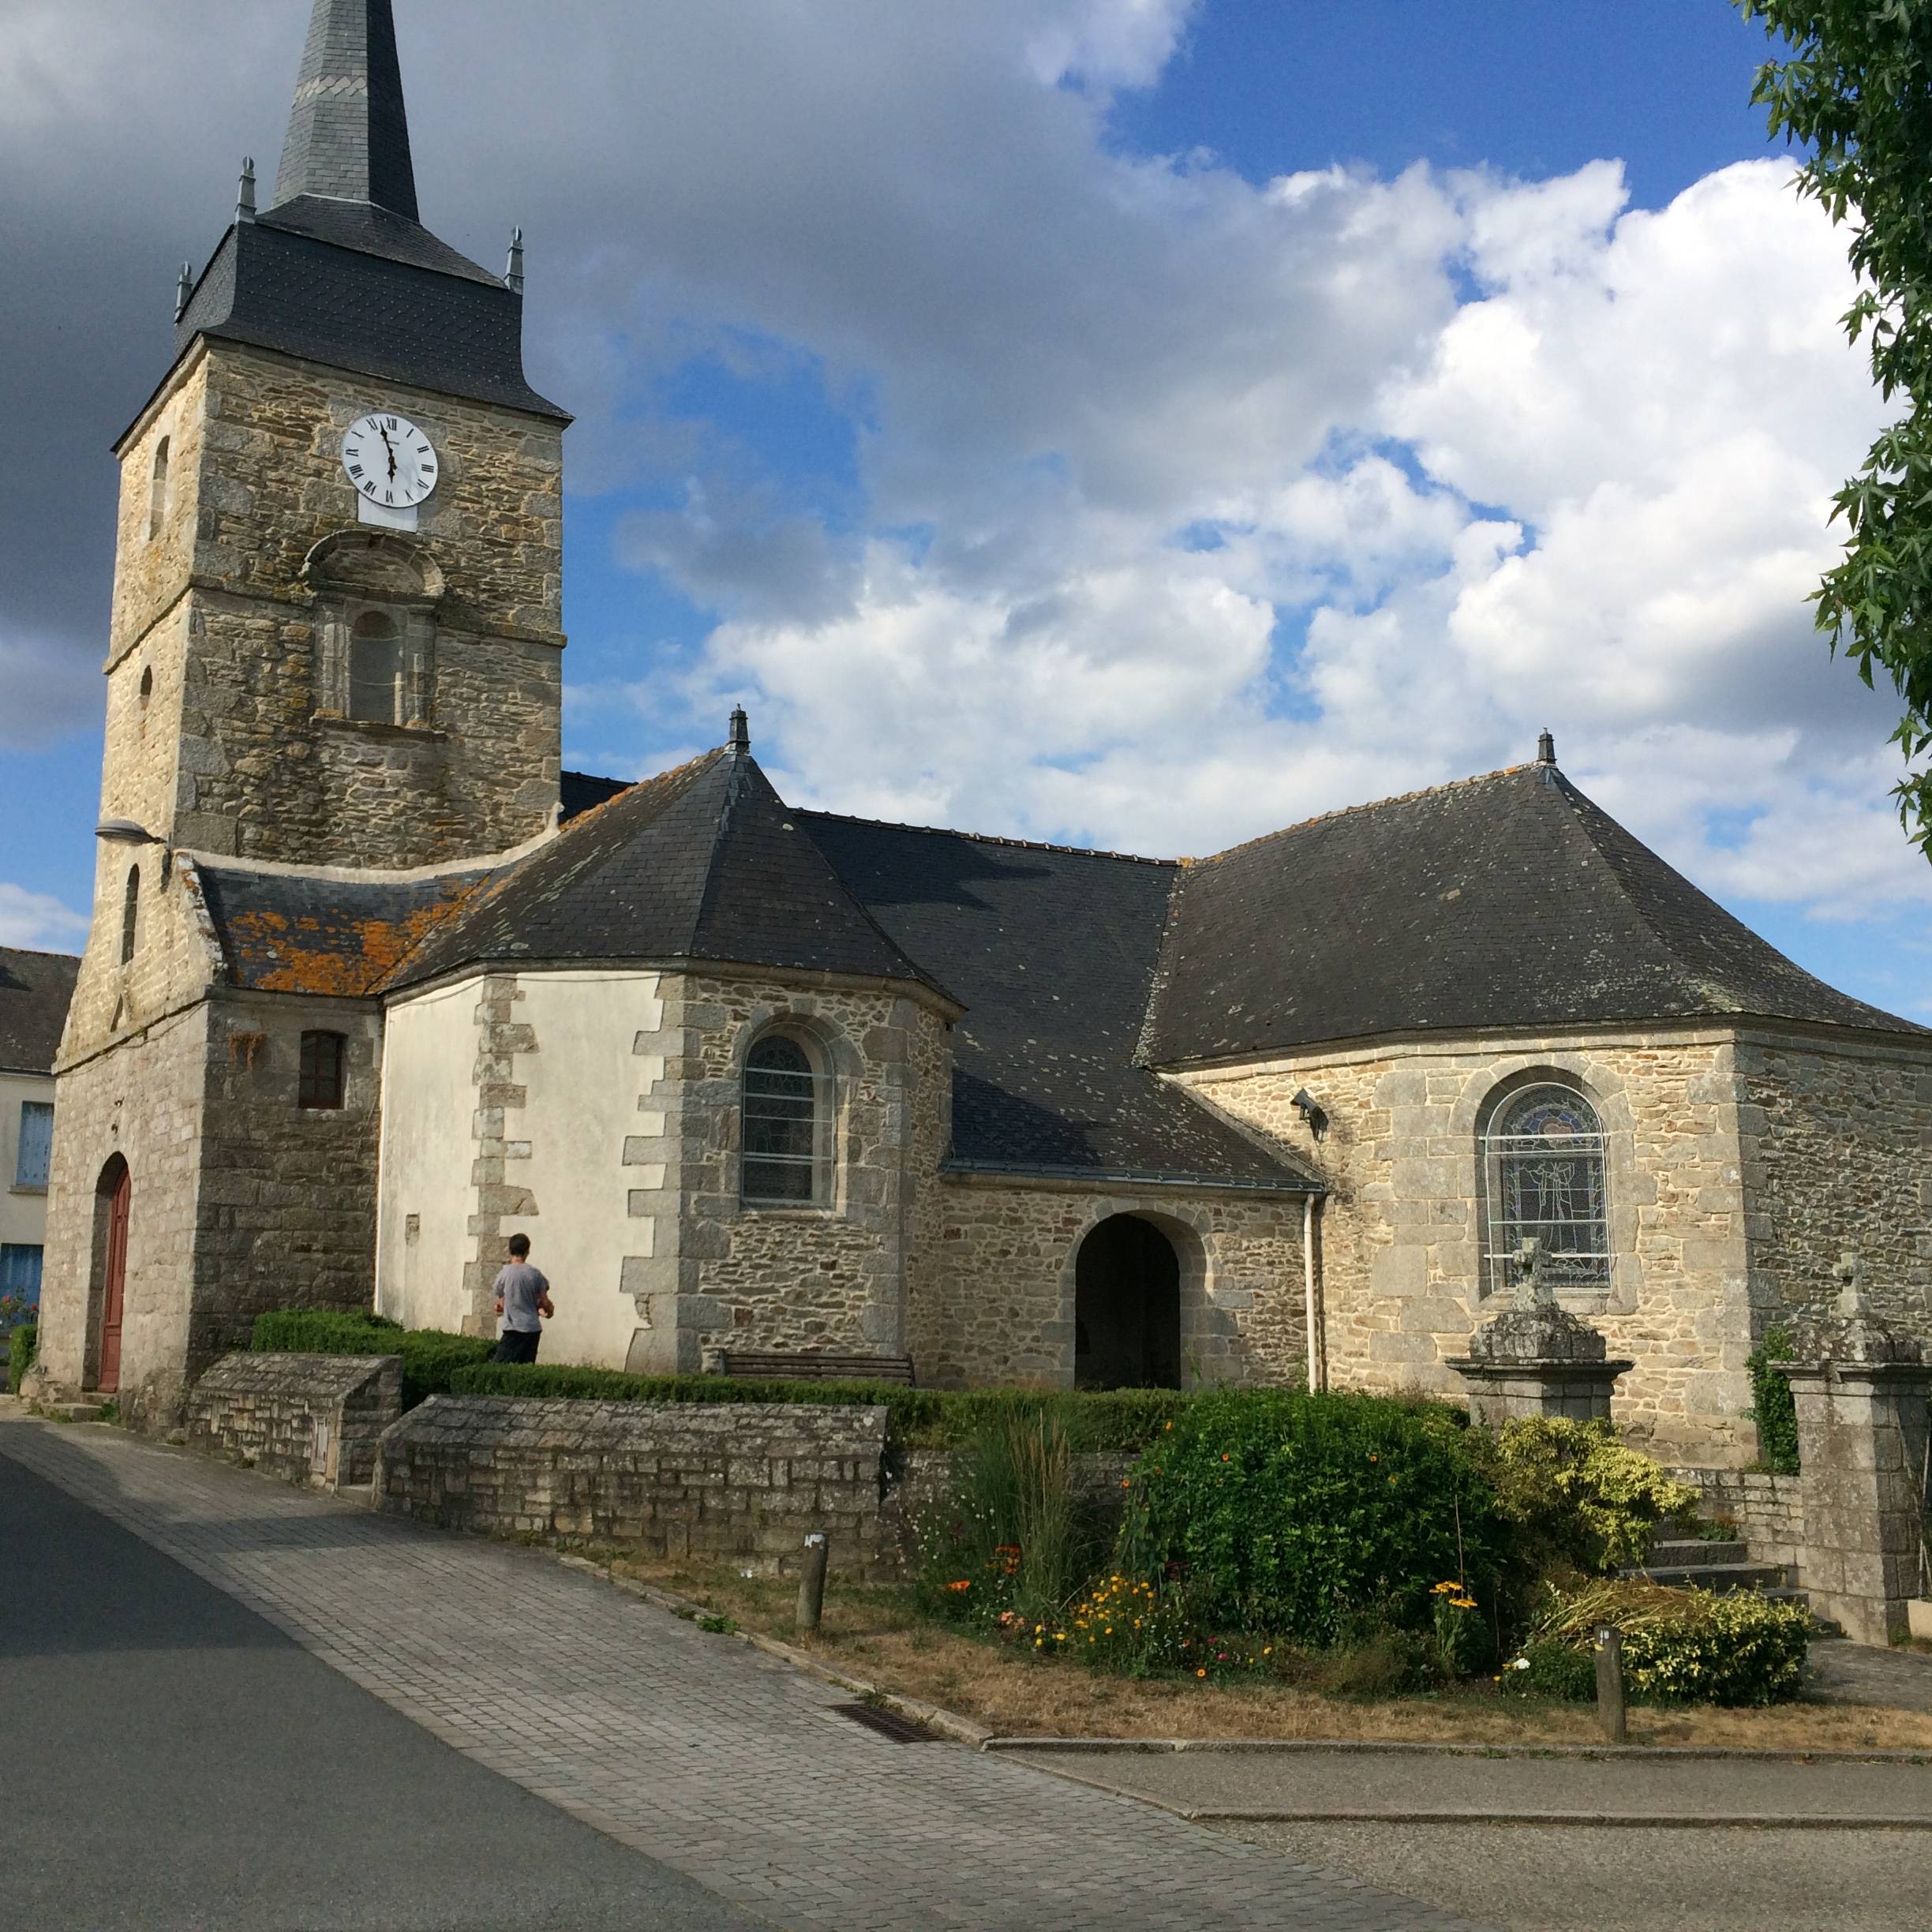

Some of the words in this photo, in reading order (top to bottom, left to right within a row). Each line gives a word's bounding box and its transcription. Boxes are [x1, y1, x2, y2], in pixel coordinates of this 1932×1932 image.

[366, 417, 378, 431] XI
[386, 417, 397, 431] XII
[406, 429, 414, 438] I
[345, 447, 359, 457] IX
[417, 445, 429, 454] II
[349, 464, 365, 480] VIII
[421, 463, 434, 474] III
[363, 480, 376, 496] VII
[385, 489, 394, 504] VI
